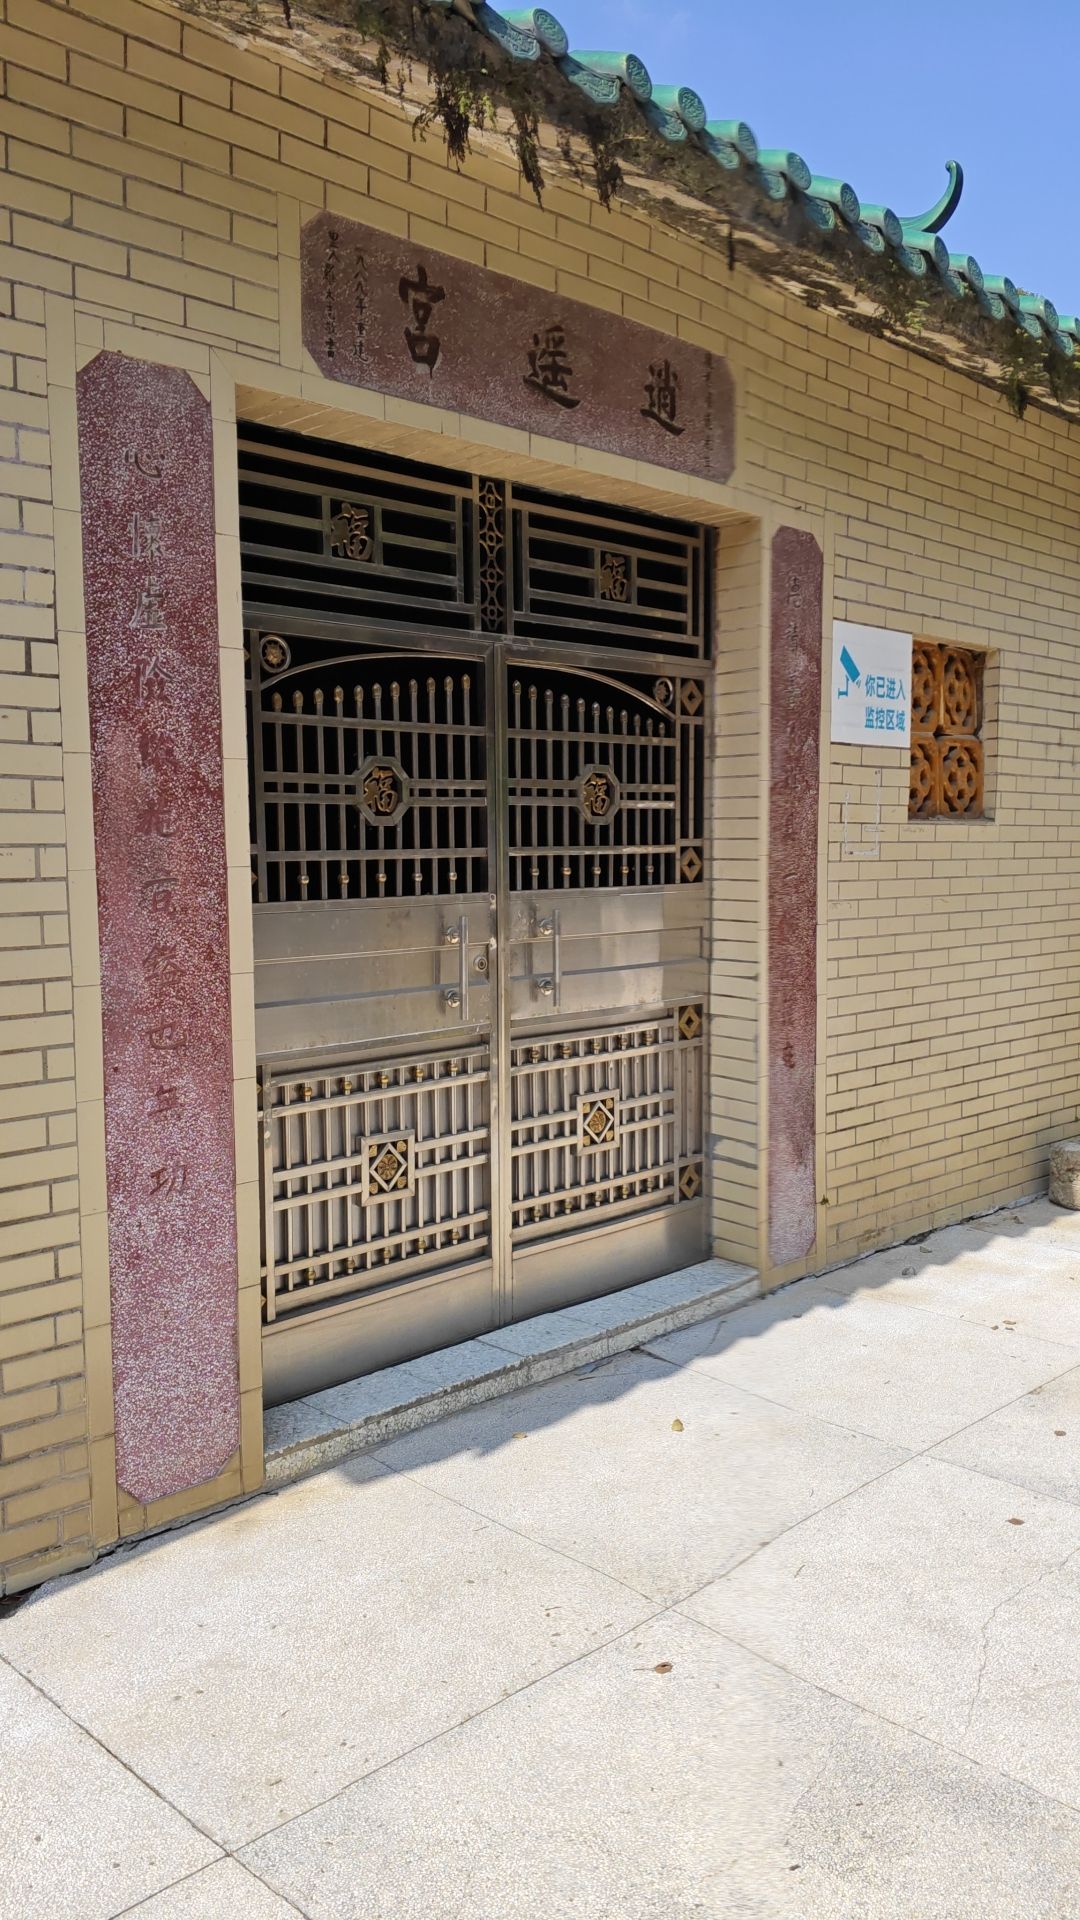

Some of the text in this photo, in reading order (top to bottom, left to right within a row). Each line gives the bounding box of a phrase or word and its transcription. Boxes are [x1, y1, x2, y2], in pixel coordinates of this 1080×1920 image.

[331, 502, 373, 560] 福
[600, 553, 627, 602] 福
[865, 674, 906, 701] 你已进入
[865, 706, 906, 732] 监控区域
[363, 766, 398, 813] 福
[583, 773, 611, 815] 福
